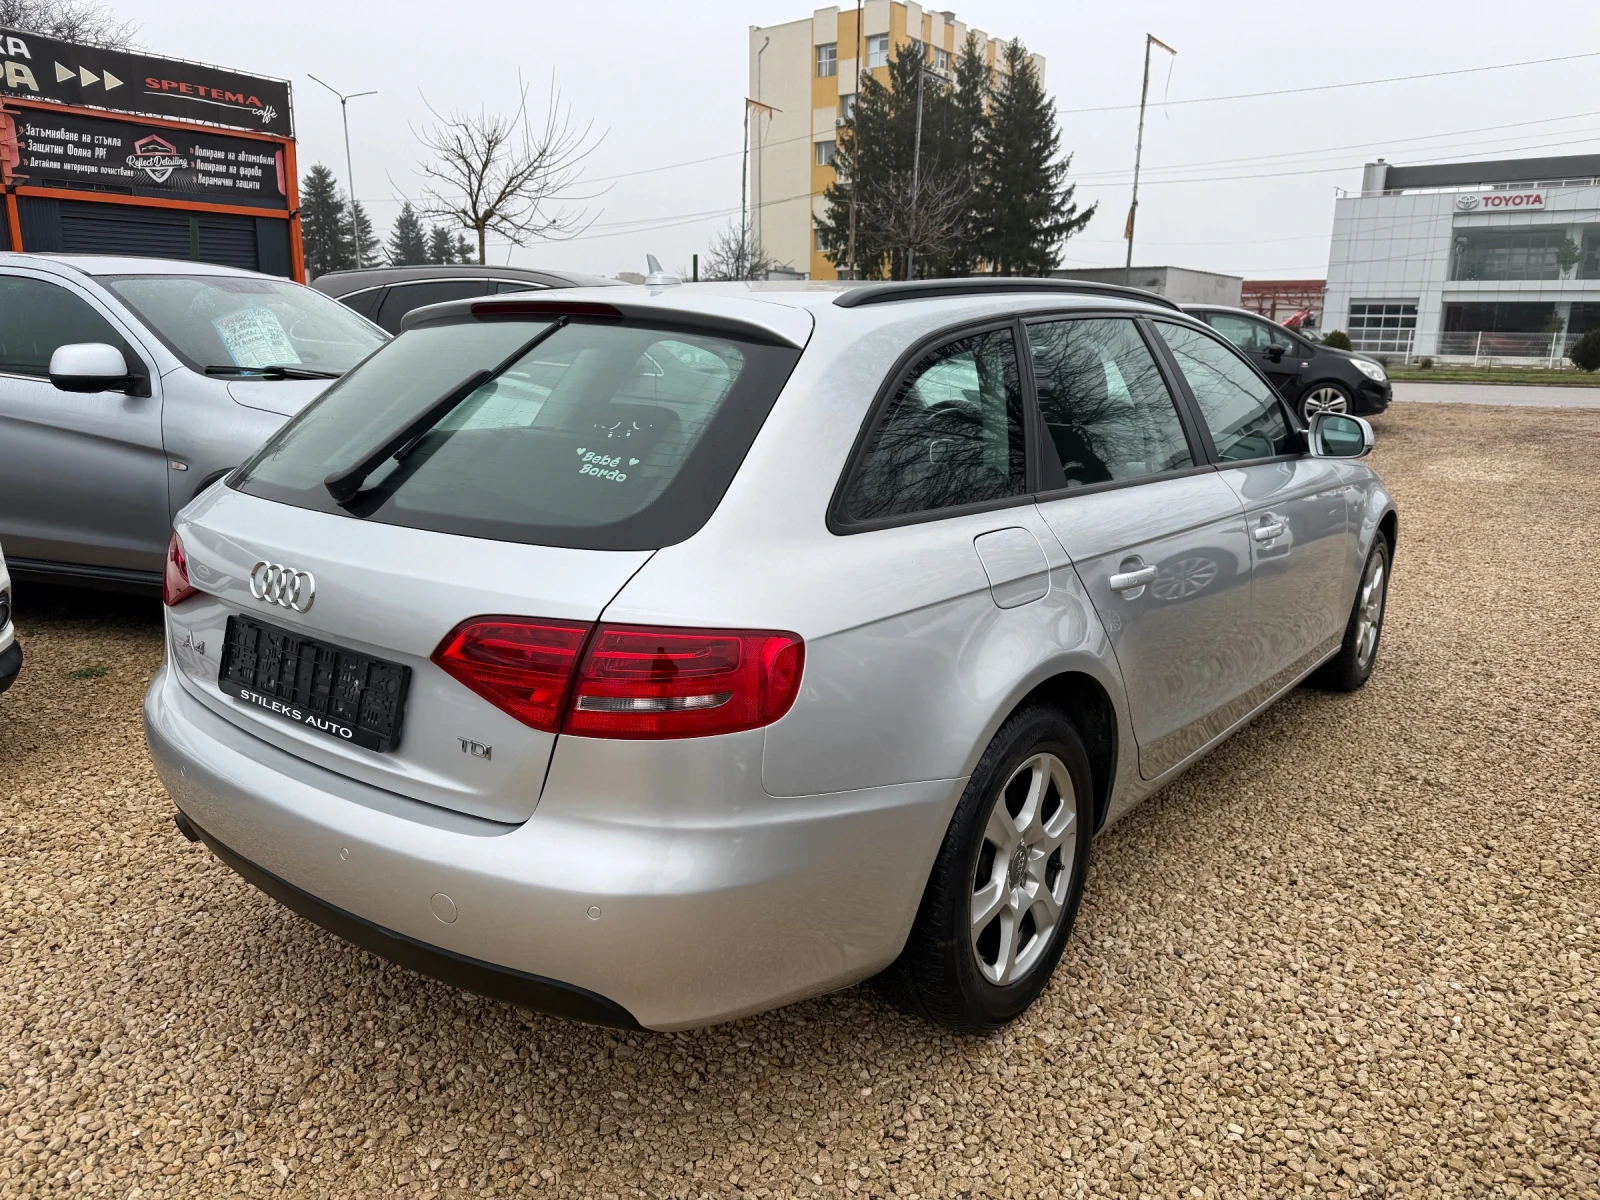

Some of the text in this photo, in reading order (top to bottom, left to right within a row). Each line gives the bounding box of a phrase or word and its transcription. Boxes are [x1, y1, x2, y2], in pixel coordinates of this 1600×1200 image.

[145, 77, 263, 108] SPETEMA
[25, 123, 122, 147] Затъмняване на стъкла
[27, 138, 64, 155] Защитни
[194, 144, 275, 165] Полиране на автомобили
[125, 154, 189, 169] Reflect Detailing
[196, 158, 262, 178] Полиране на фарове
[235, 179, 260, 190] защити
[1482, 194, 1543, 208] TOYOTA
[581, 451, 621, 468] Bebé
[578, 463, 627, 482] Bordo
[182, 630, 206, 655] A4
[240, 689, 353, 739] STILEKS AUTO
[457, 735, 493, 762] TDI
